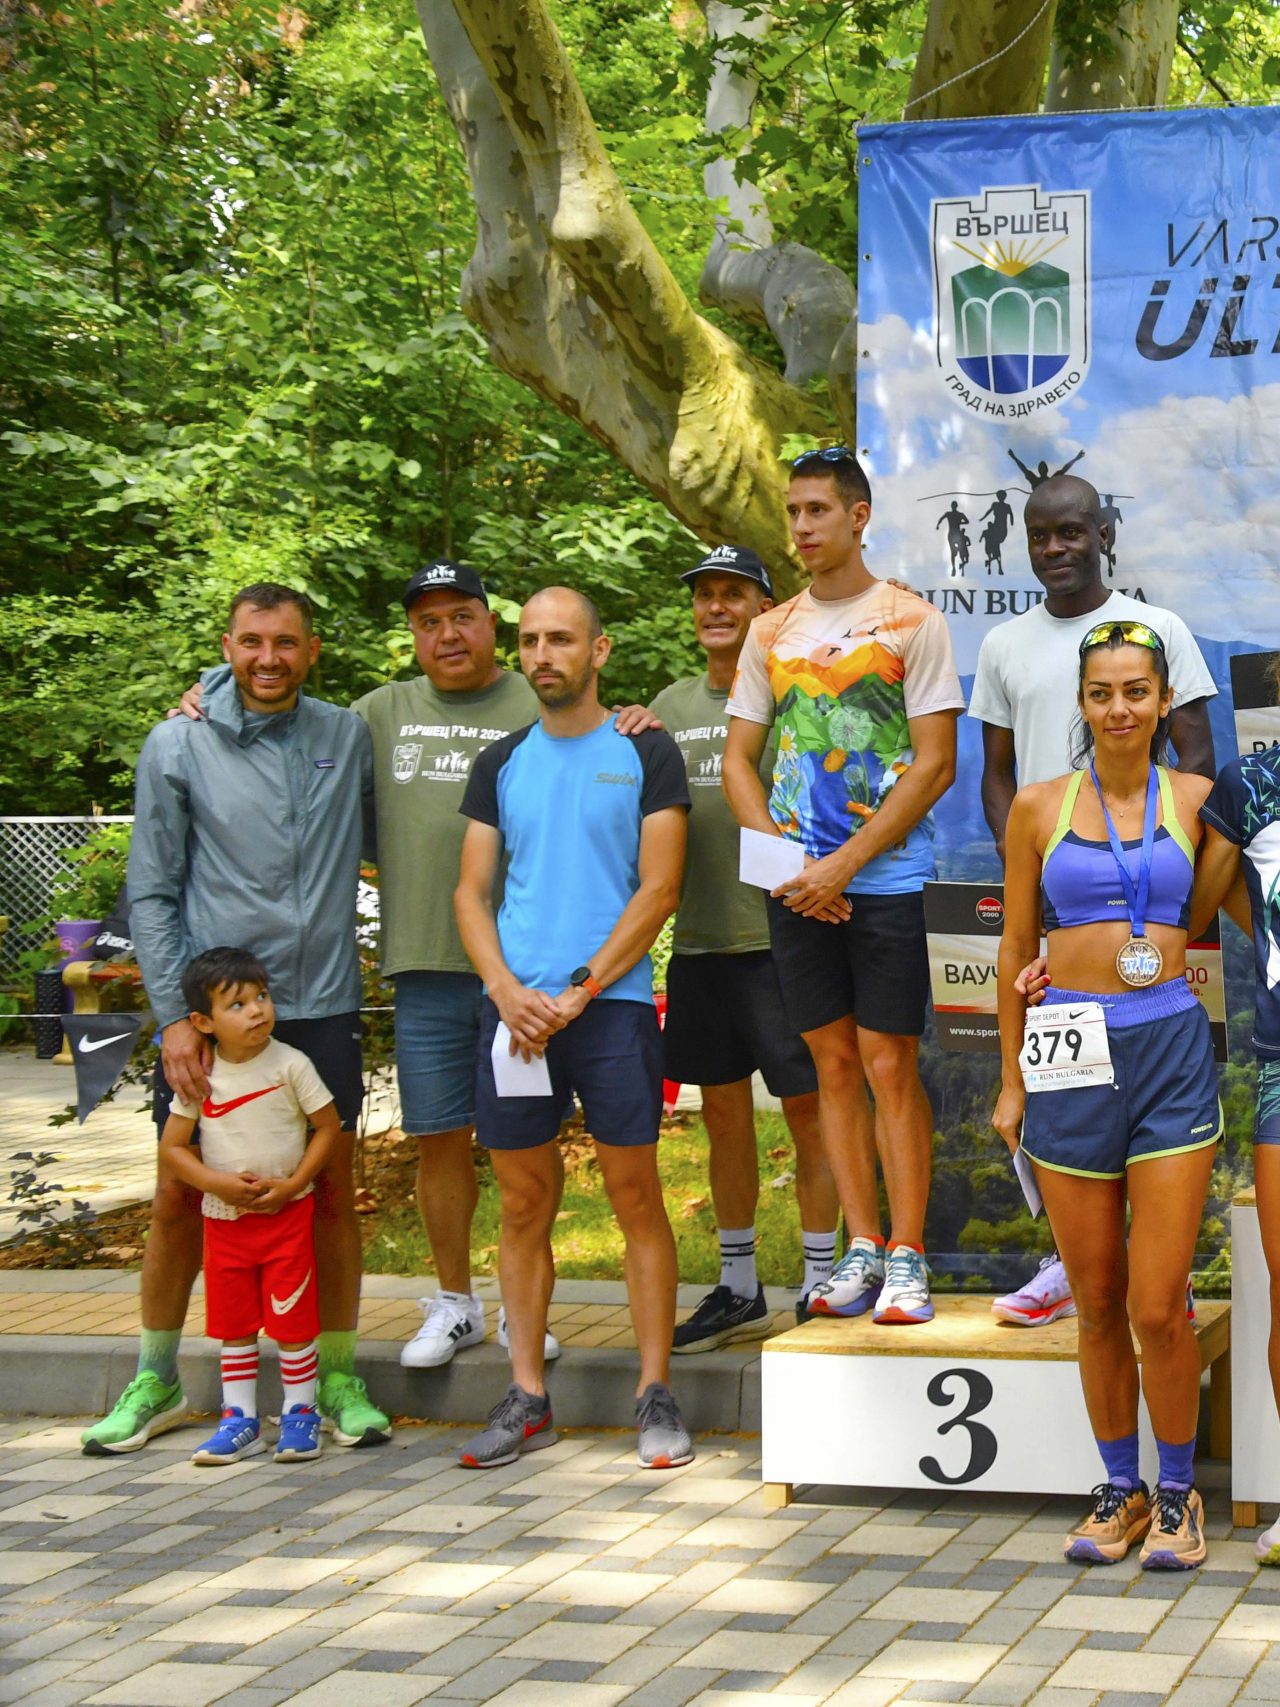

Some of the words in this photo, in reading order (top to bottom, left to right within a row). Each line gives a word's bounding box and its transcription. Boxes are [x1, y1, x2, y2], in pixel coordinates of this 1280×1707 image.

[956, 211, 1069, 237] ВЪРШЕЦ
[945, 374, 983, 411] ГРАД
[984, 403, 1006, 417] НА
[1008, 371, 1081, 418] ЗДРАВЕТО
[916, 589, 977, 615] UN
[399, 724, 450, 739] ВЪРШЕЦ
[451, 725, 478, 738] РЪН
[712, 725, 729, 738] РЪ
[944, 963, 998, 986] ВАУ
[1027, 1028, 1083, 1066] 379
[1039, 1072, 1054, 1081] RUN
[1056, 1068, 1094, 1079] BULGARIA
[918, 1367, 998, 1485] 3
